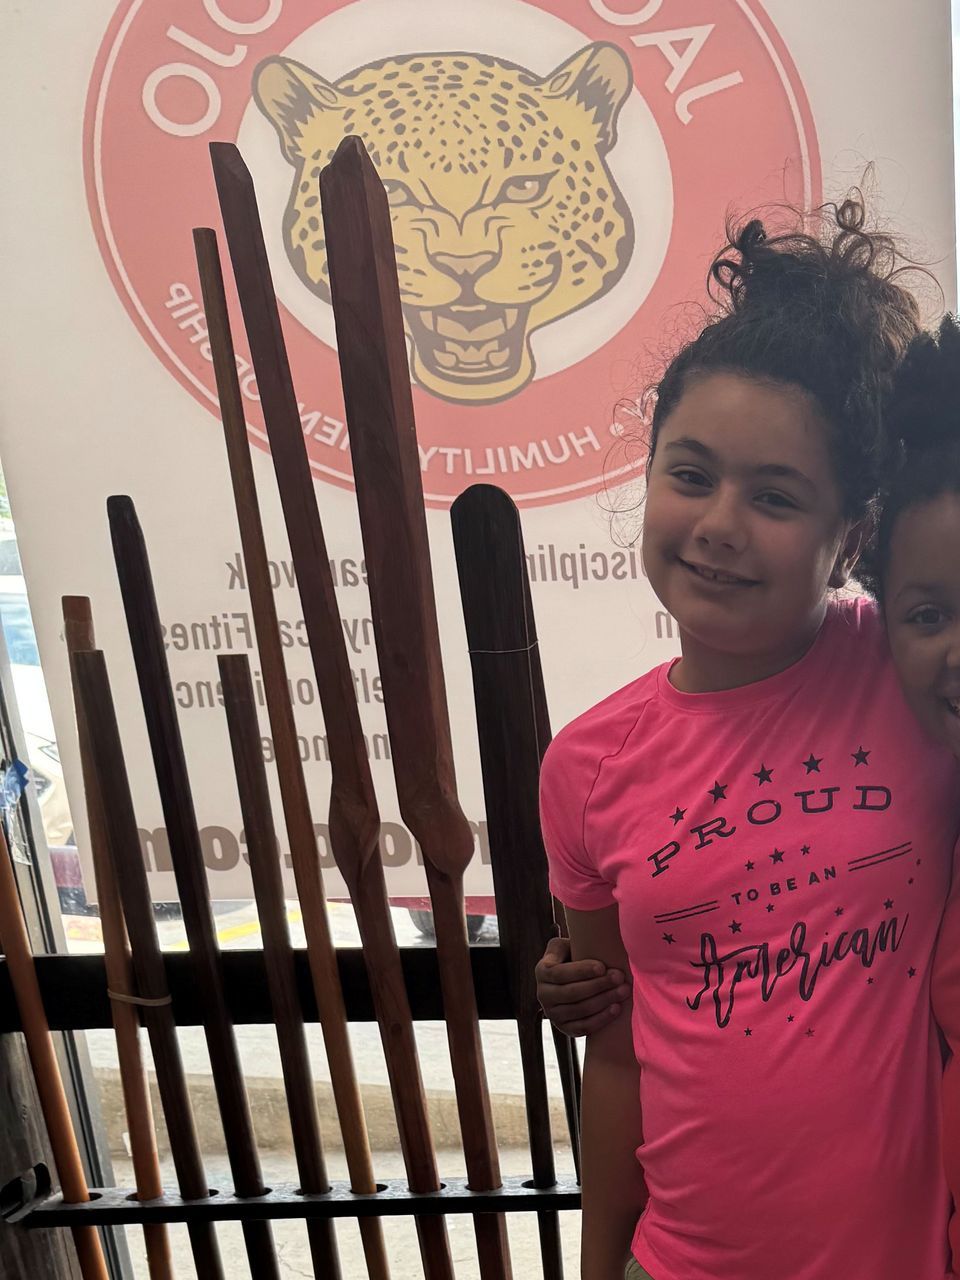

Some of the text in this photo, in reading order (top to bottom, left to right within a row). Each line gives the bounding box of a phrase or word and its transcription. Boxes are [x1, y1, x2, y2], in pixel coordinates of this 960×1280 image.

[647, 784, 892, 878] PROUD
[731, 865, 837, 906] TO BE AN
[686, 913, 909, 1028] American
